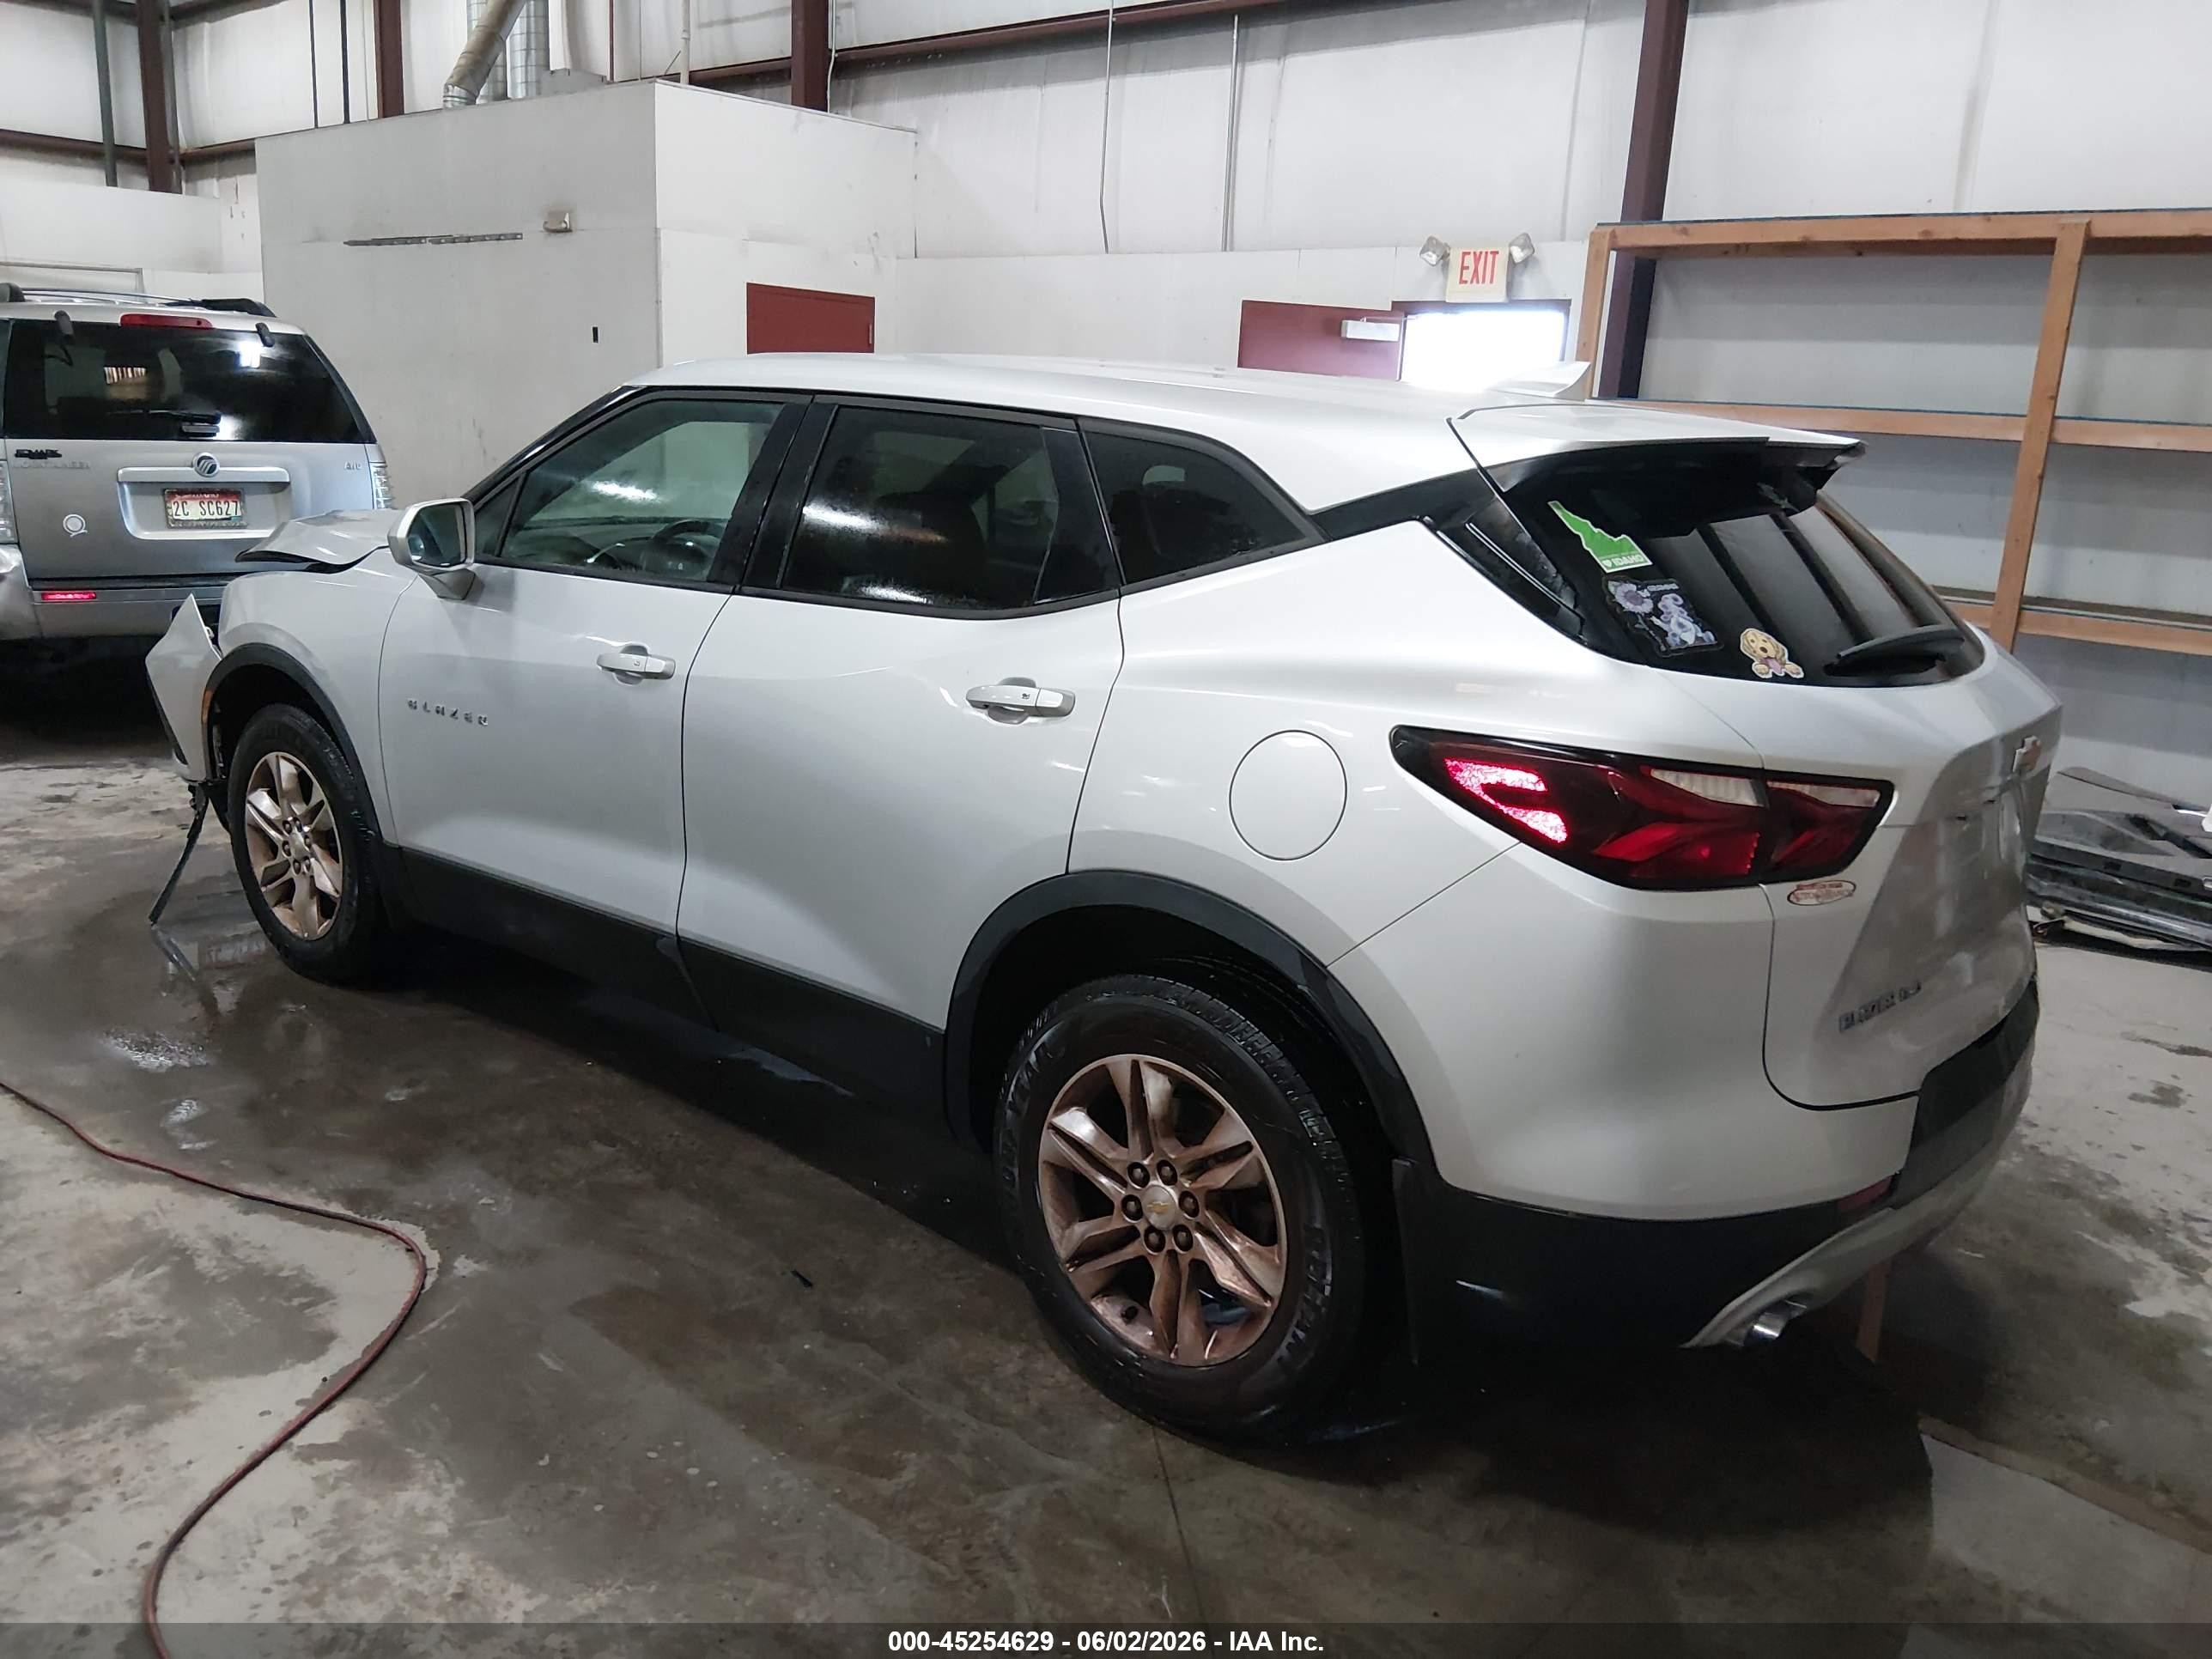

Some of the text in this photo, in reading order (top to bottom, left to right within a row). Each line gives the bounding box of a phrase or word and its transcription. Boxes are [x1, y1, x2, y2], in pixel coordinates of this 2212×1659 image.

[1459, 250, 1499, 285] EXIT
[173, 501, 239, 517] 2C SC627
[408, 699, 488, 726] BLAZER
